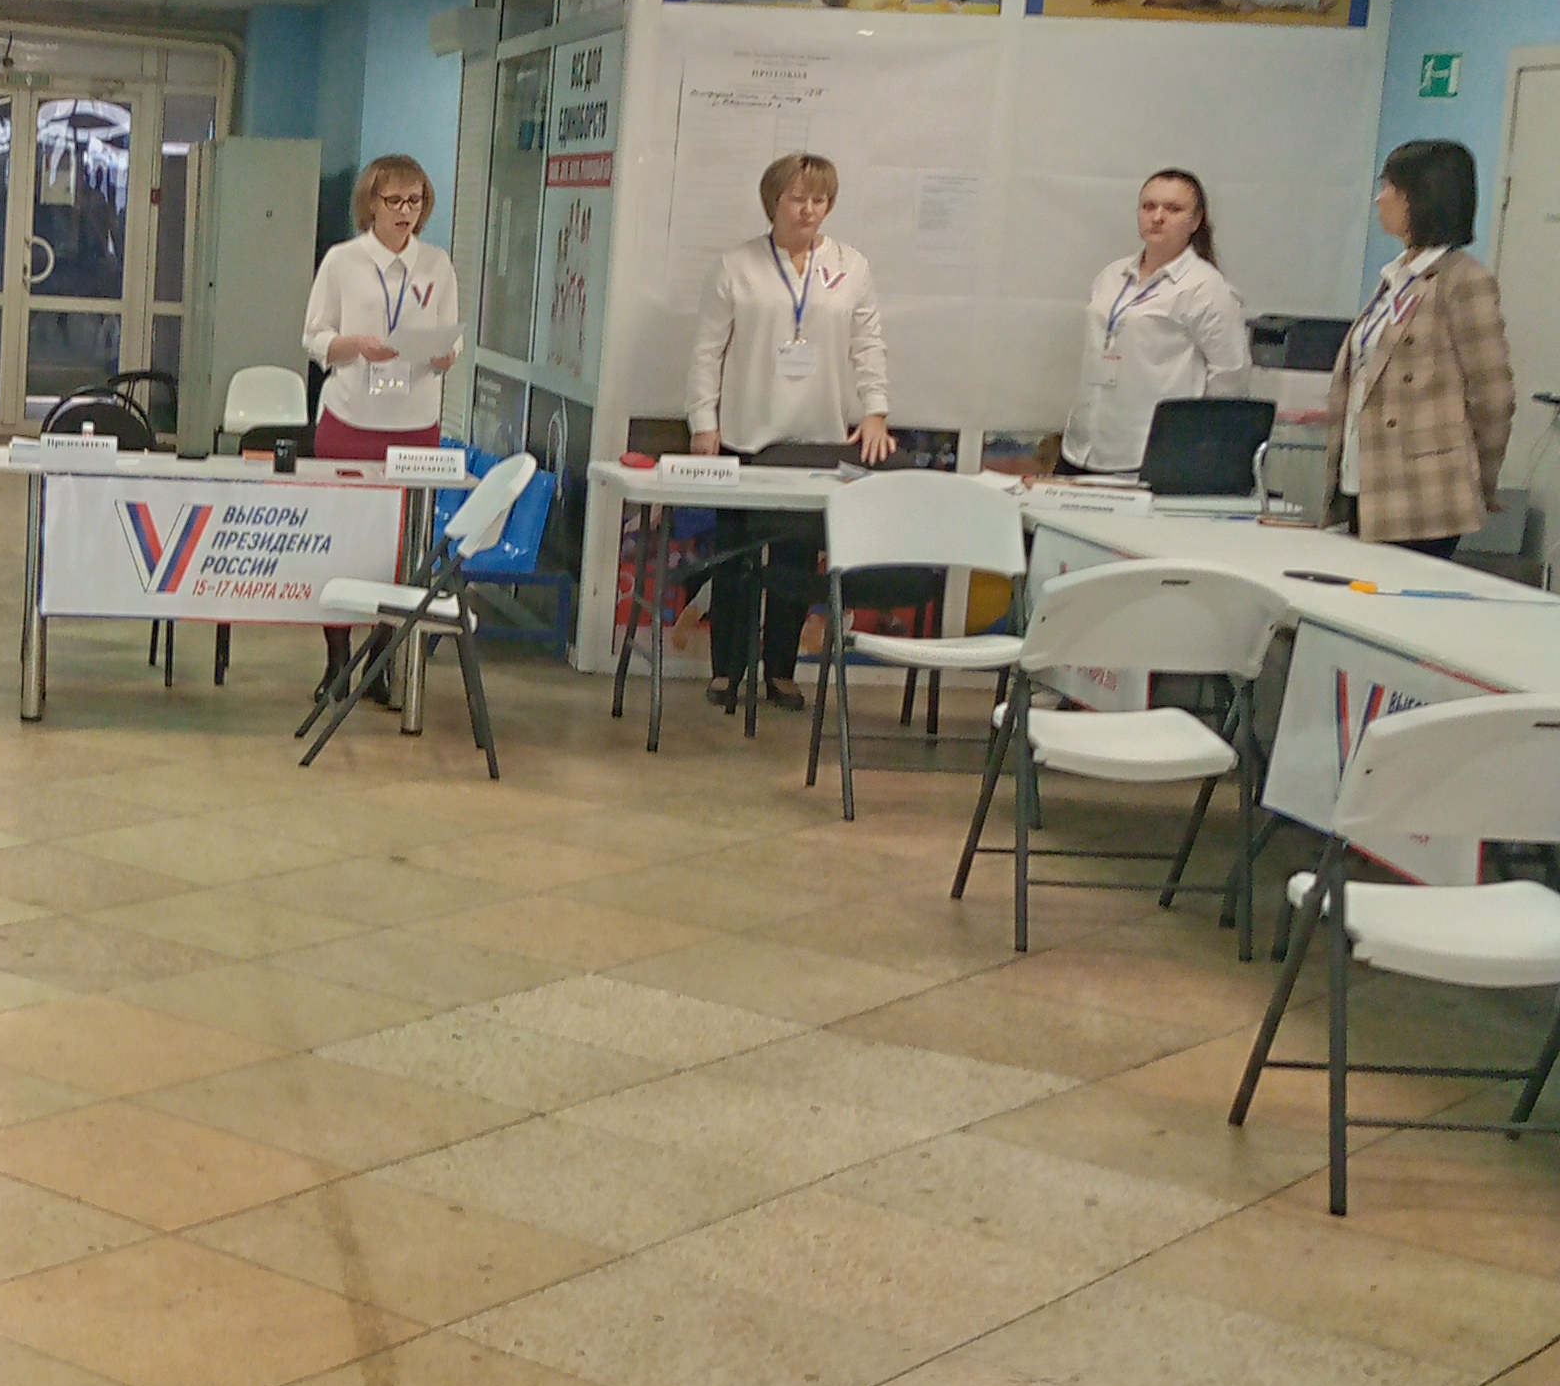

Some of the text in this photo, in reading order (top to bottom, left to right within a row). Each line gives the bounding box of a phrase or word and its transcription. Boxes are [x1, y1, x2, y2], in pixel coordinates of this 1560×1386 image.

[223, 504, 309, 527] ВЫБОРЫ
[211, 529, 333, 555] ПРЕЗИДЕНТА
[200, 554, 280, 578] РОССИИ
[231, 579, 278, 601] МАРТА
[279, 581, 313, 601] 2024
